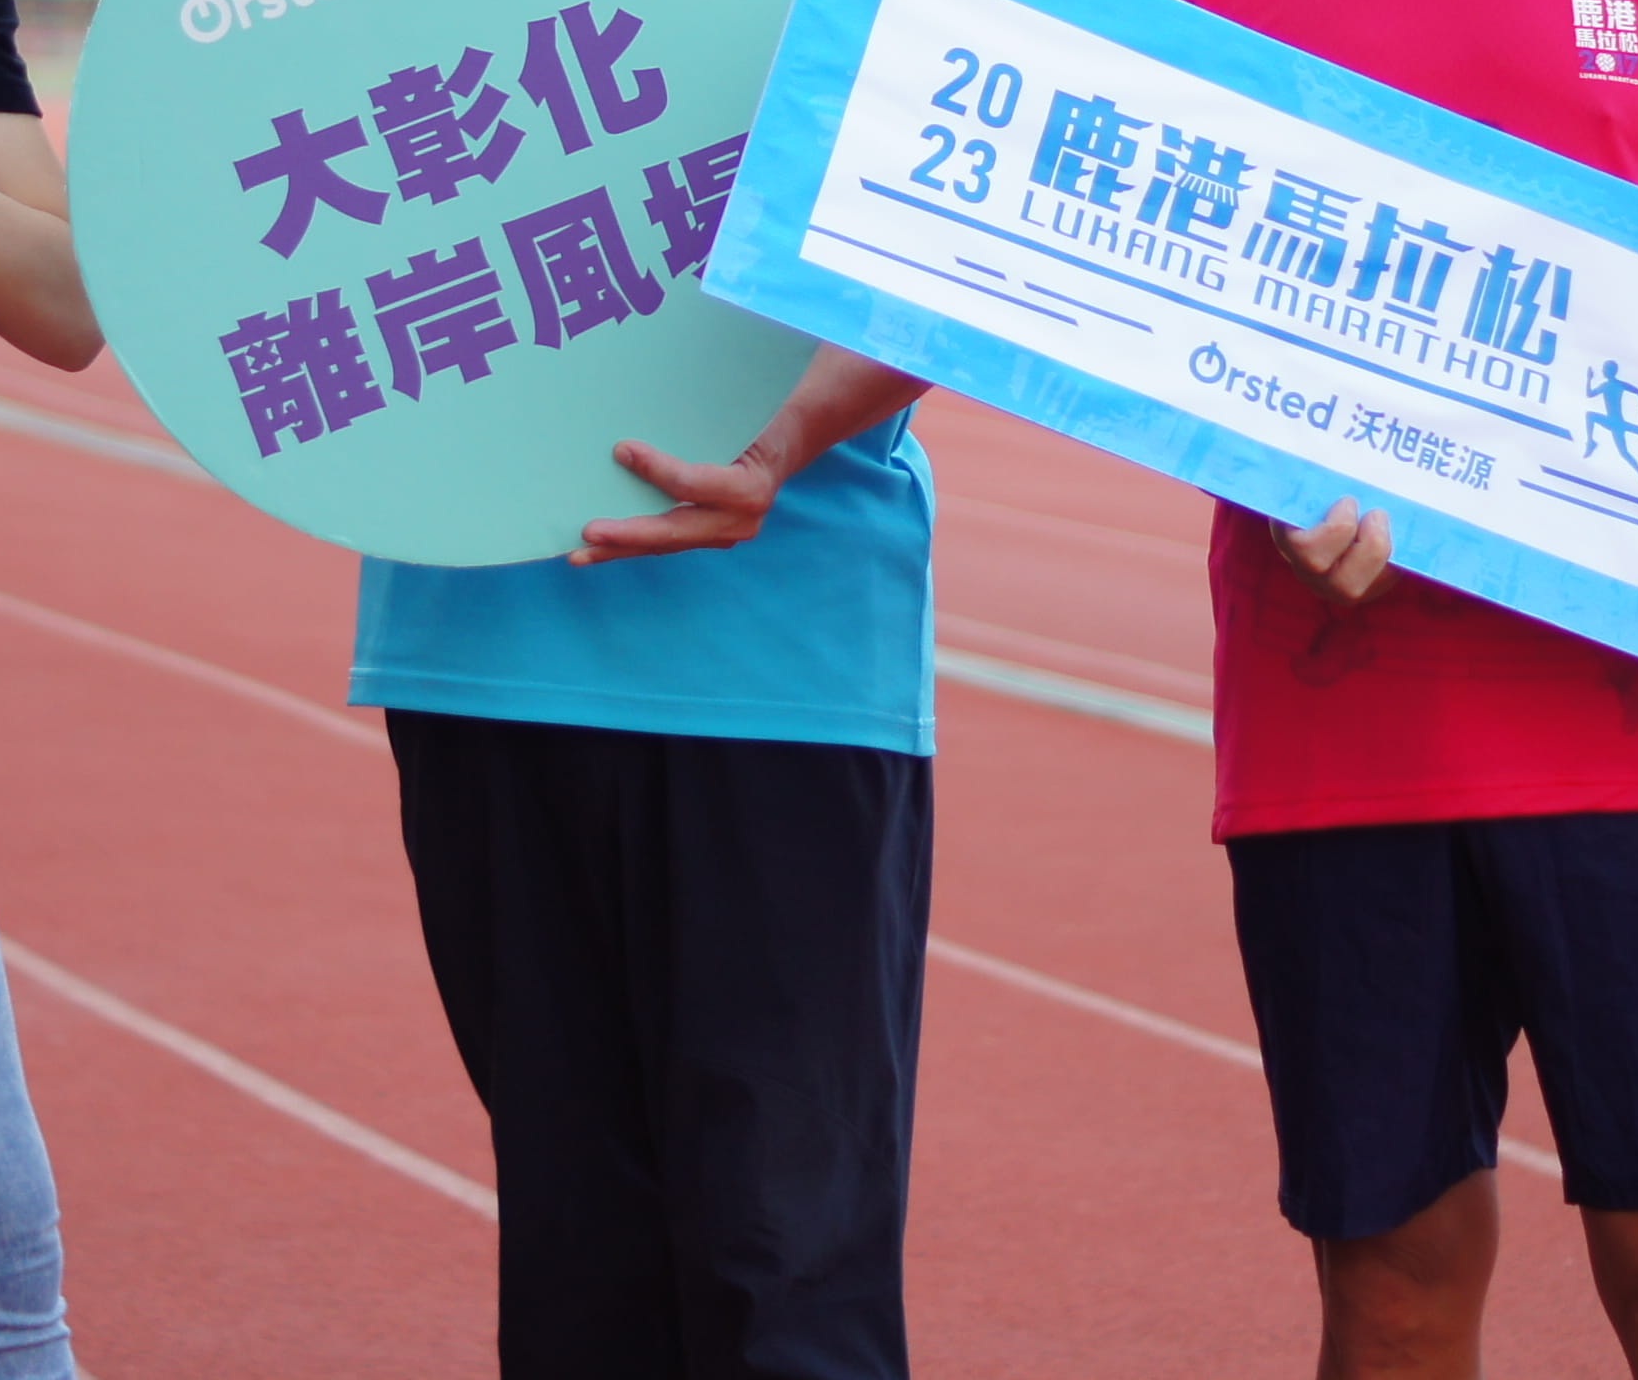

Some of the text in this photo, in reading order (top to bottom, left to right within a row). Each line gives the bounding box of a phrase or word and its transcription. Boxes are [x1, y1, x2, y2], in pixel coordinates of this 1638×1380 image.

[232, 0, 669, 260] 大彰化
[909, 124, 997, 204] 23
[930, 47, 1023, 129] 20
[1020, 189, 1551, 405] LUKANG MARATHON
[1029, 89, 1572, 366] 鹿港馬拉松
[1343, 403, 1497, 491] 沃旭能源
